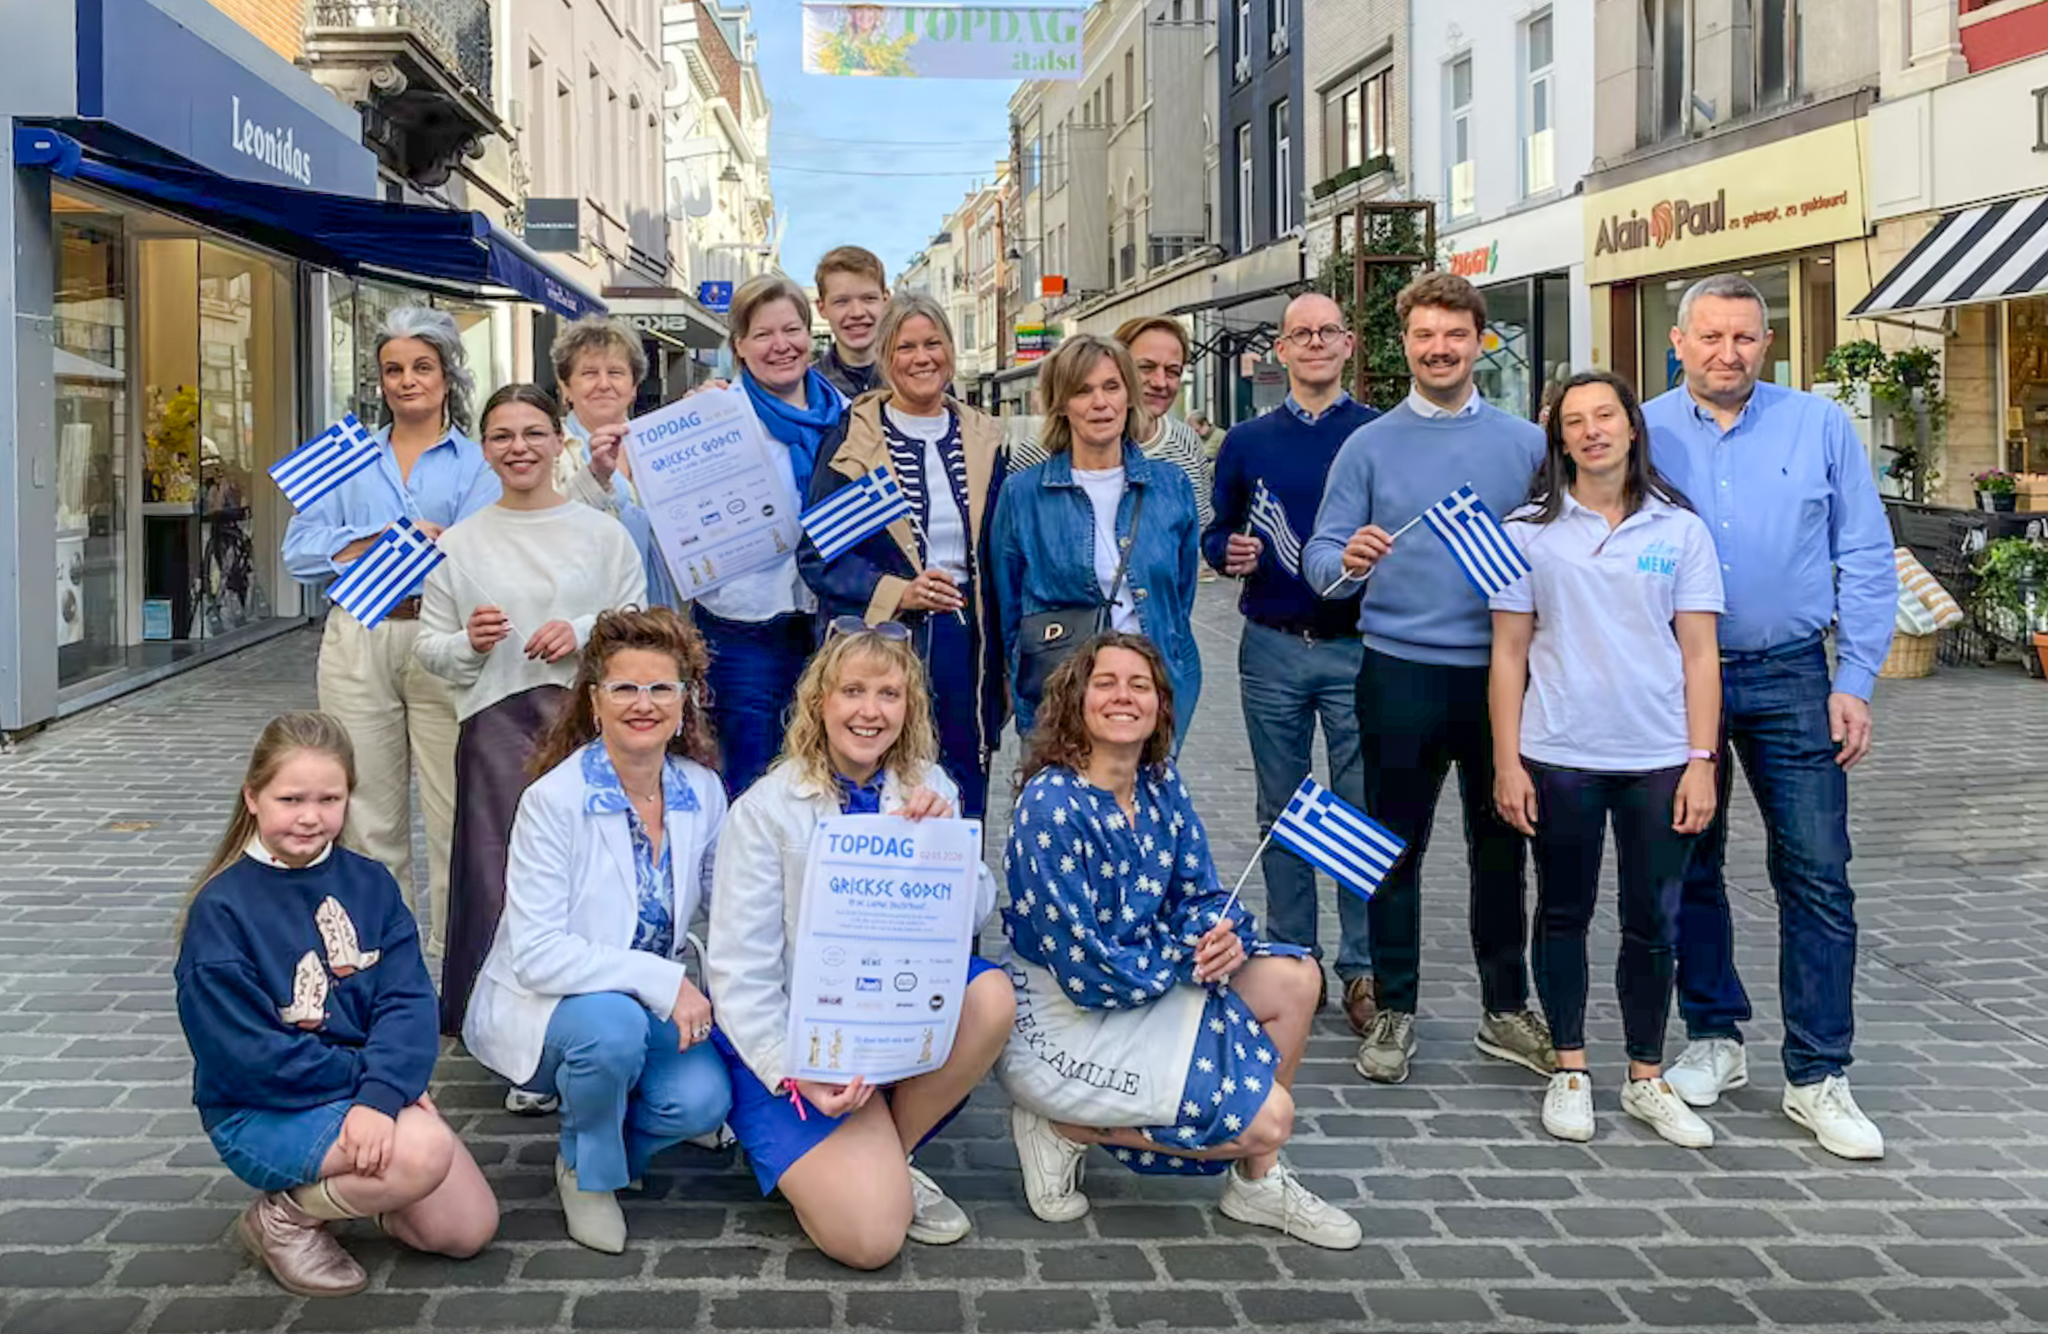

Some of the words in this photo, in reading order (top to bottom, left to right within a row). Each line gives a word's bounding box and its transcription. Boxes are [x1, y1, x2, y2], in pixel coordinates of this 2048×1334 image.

[899, 8, 1077, 43] TOPDAG
[1012, 50, 1076, 71] aalst
[231, 94, 312, 186] Leonidas
[1594, 209, 1649, 257] Alain
[1674, 188, 1726, 241] Paul
[636, 410, 702, 447] TOPDAG
[829, 833, 915, 859] TOPDAG
[829, 876, 895, 898] GRIEKSE
[899, 881, 951, 901] GODEN
[1038, 1042, 1141, 1096] AMILLE
